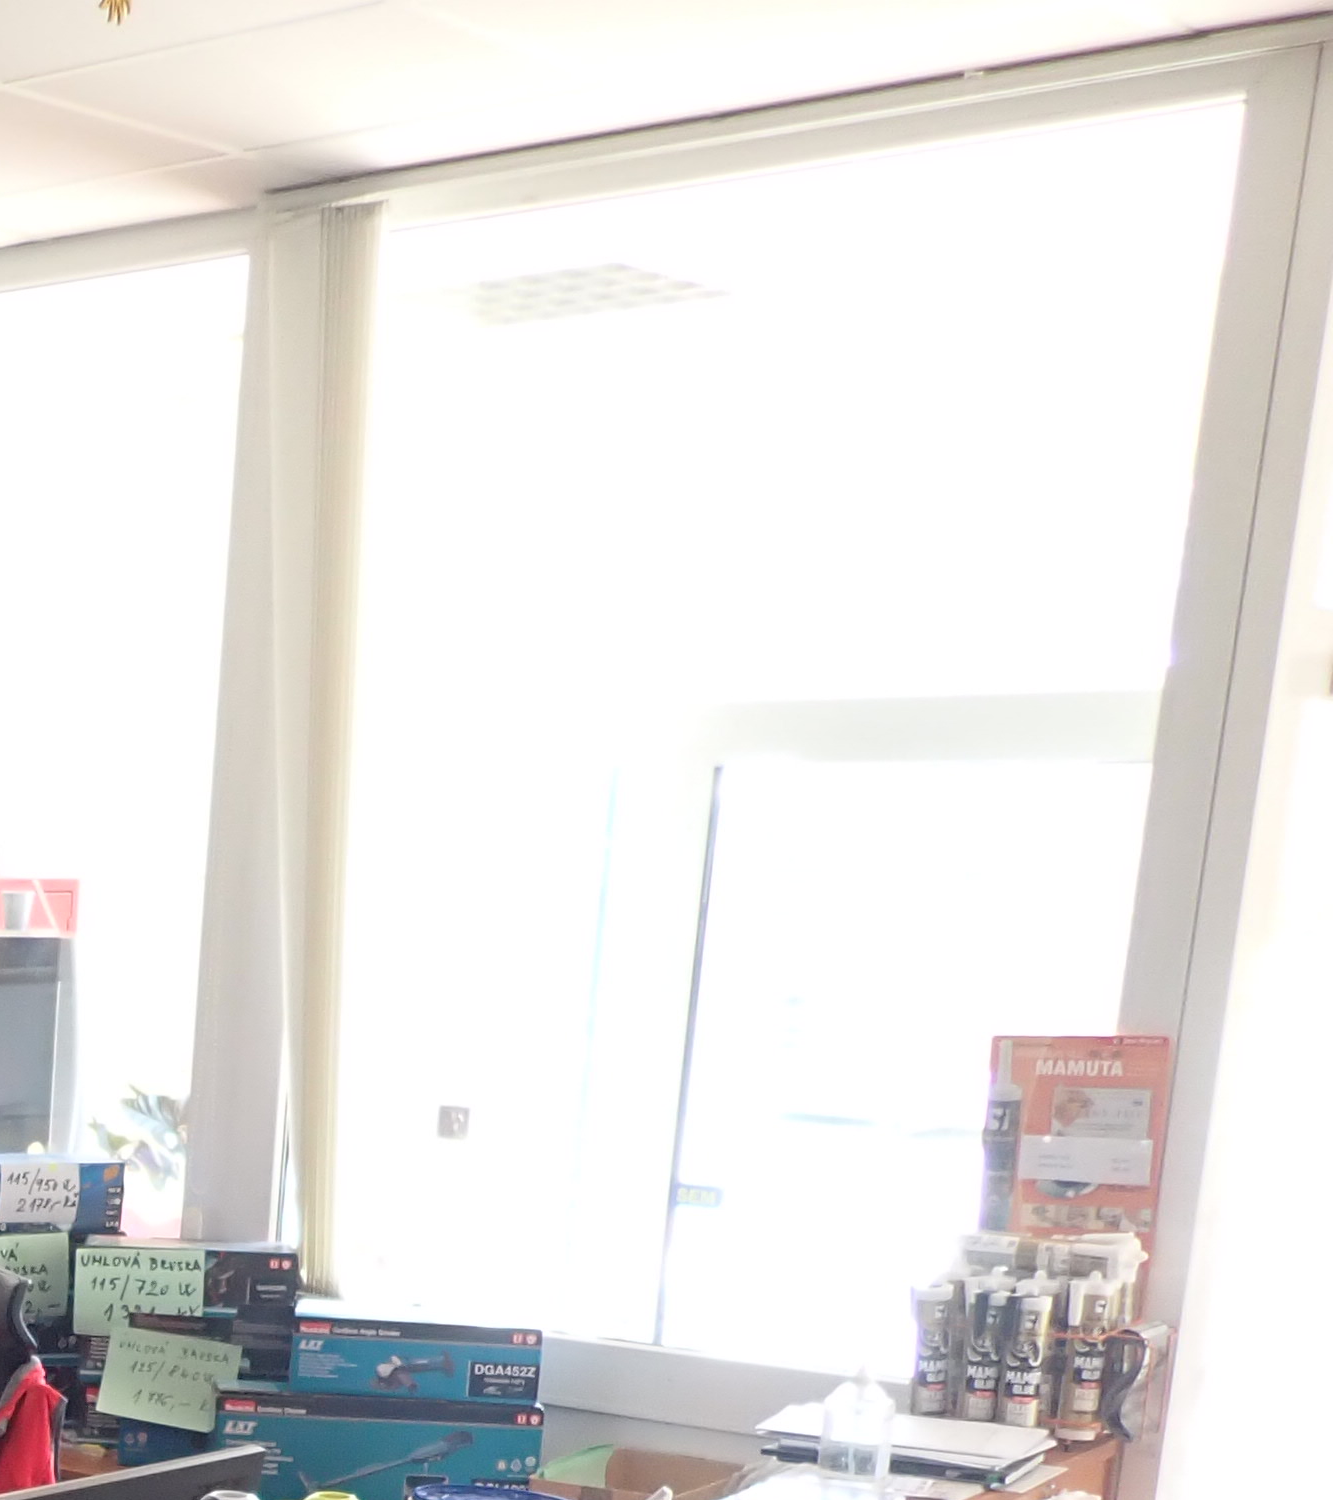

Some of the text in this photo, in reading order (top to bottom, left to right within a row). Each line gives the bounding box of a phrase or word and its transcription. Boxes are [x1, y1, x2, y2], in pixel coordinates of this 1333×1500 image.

[1036, 1059, 1124, 1077] MAMUTA
[474, 1364, 536, 1378] DGA452Z
[223, 1420, 258, 1435] LXT
